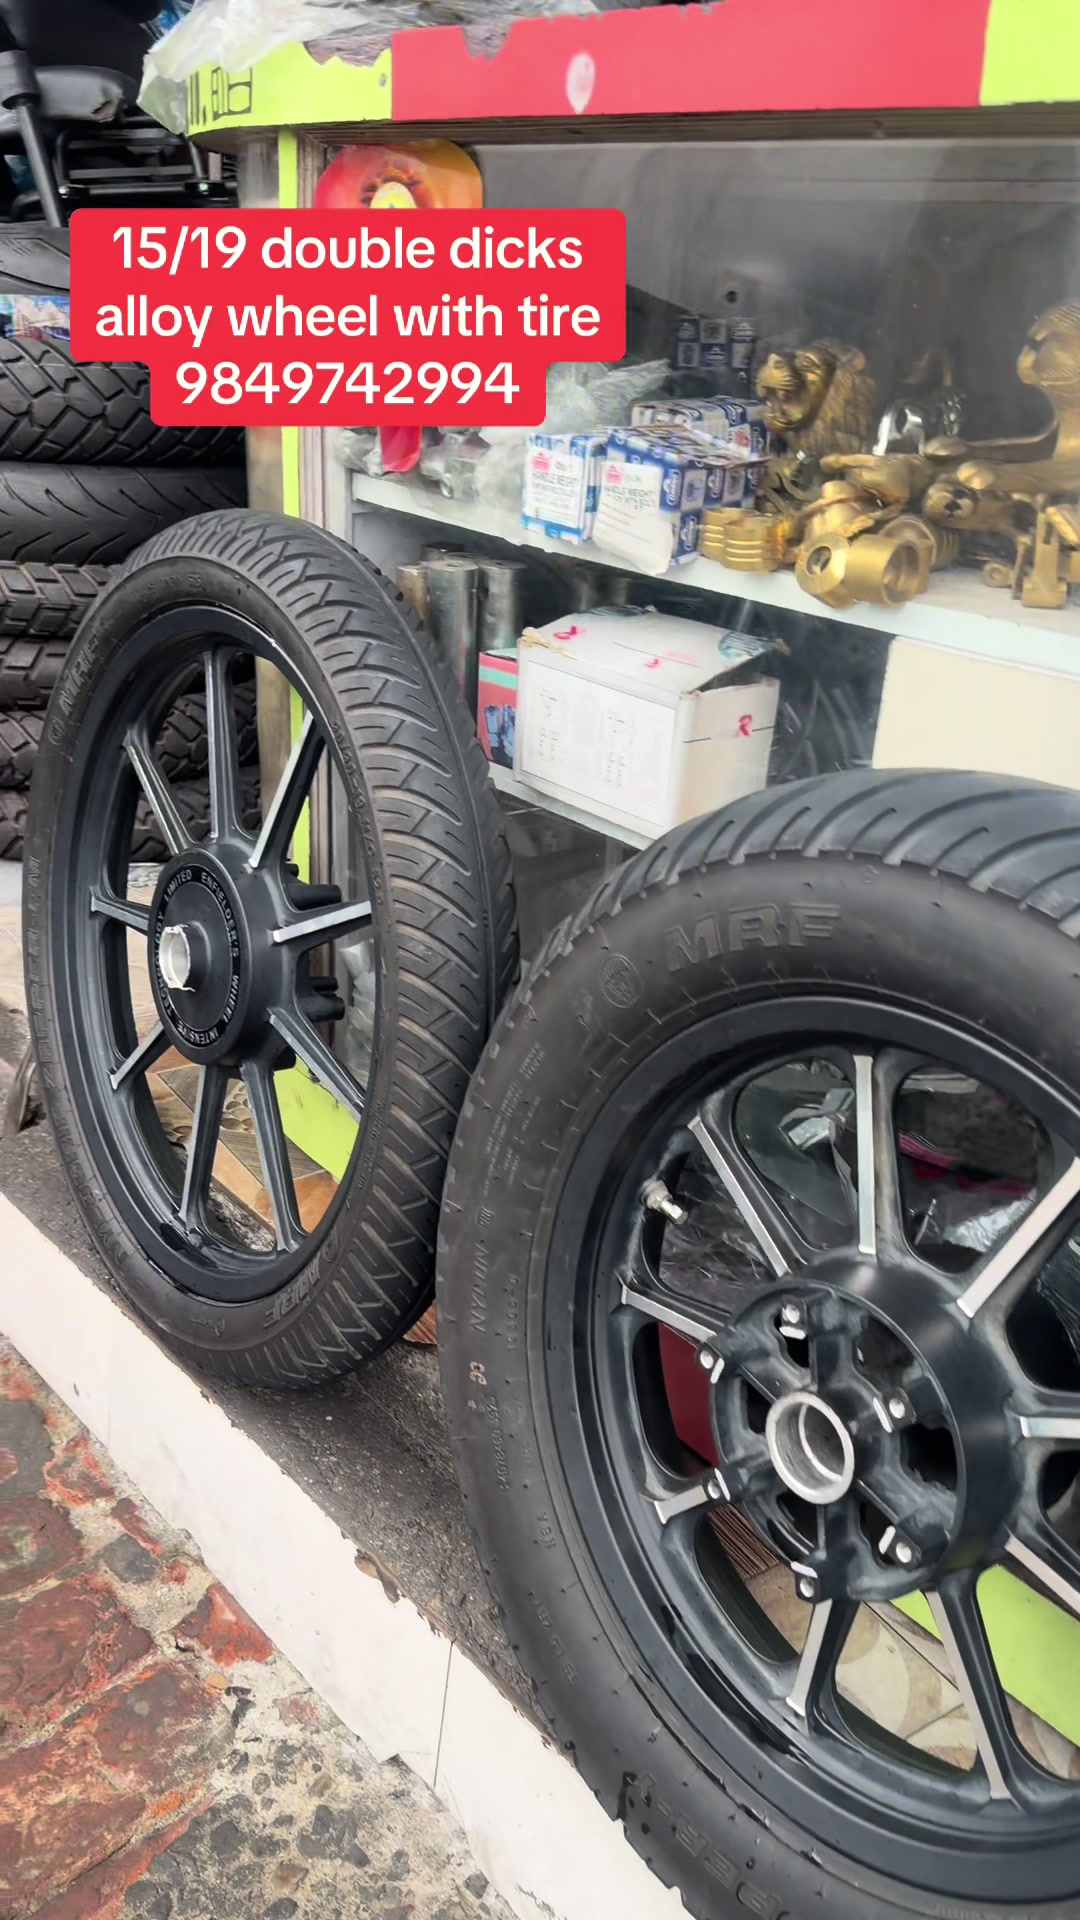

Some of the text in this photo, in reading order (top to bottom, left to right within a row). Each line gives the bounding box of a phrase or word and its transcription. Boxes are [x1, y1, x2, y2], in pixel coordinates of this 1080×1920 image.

[162, 868, 193, 902] LIMITED
[201, 872, 240, 958] ENFIELDER'S
[664, 901, 842, 973] MRF
[220, 974, 241, 1027] WHEEL
[263, 1255, 321, 1330] MRF
